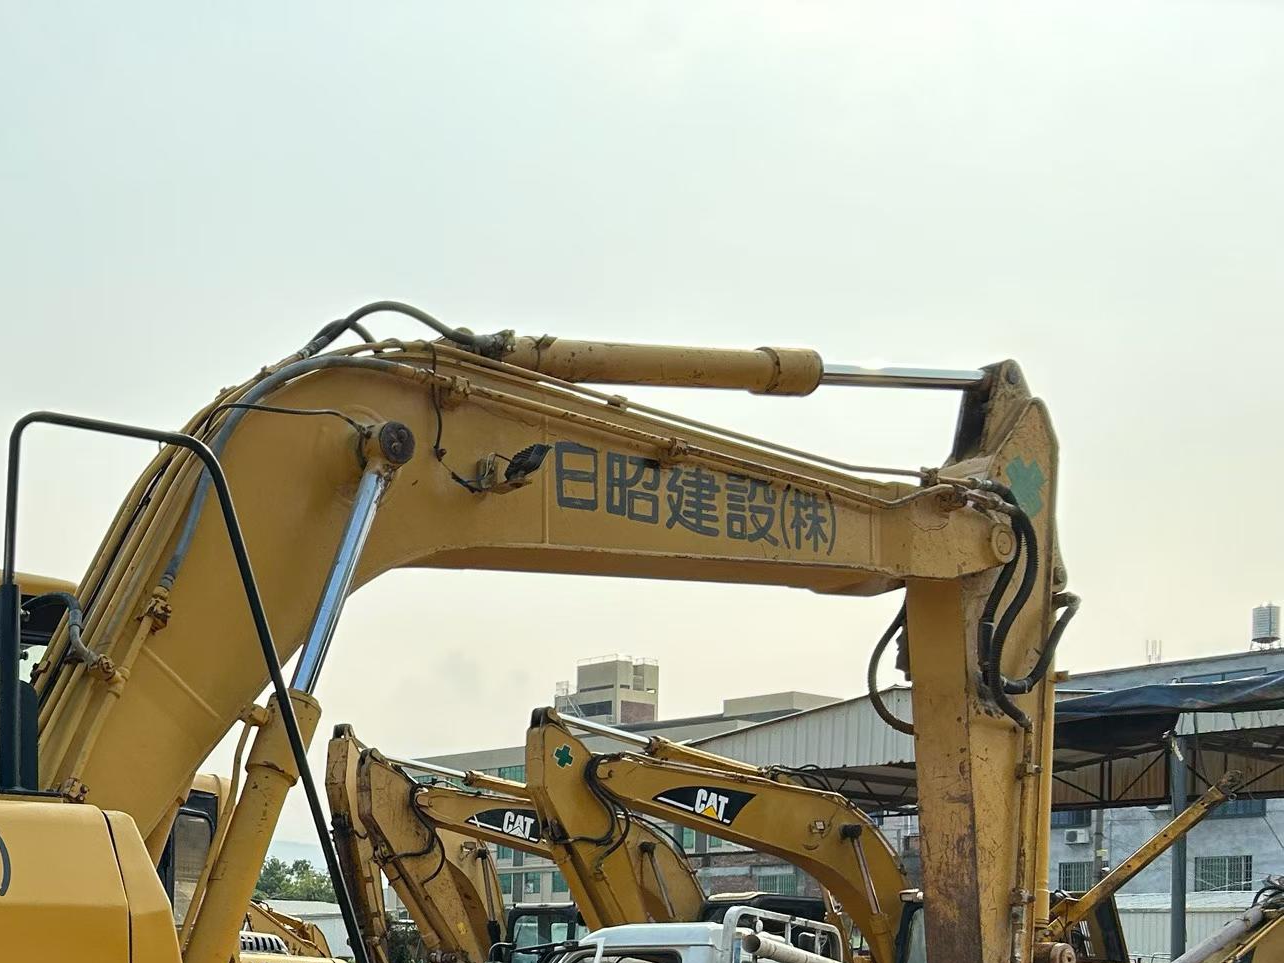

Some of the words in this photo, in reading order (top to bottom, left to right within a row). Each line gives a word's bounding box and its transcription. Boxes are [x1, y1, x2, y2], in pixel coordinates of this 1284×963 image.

[555, 441, 836, 556] 日昭建設(株)
[694, 788, 729, 821] CAT
[503, 811, 535, 839] CAT
